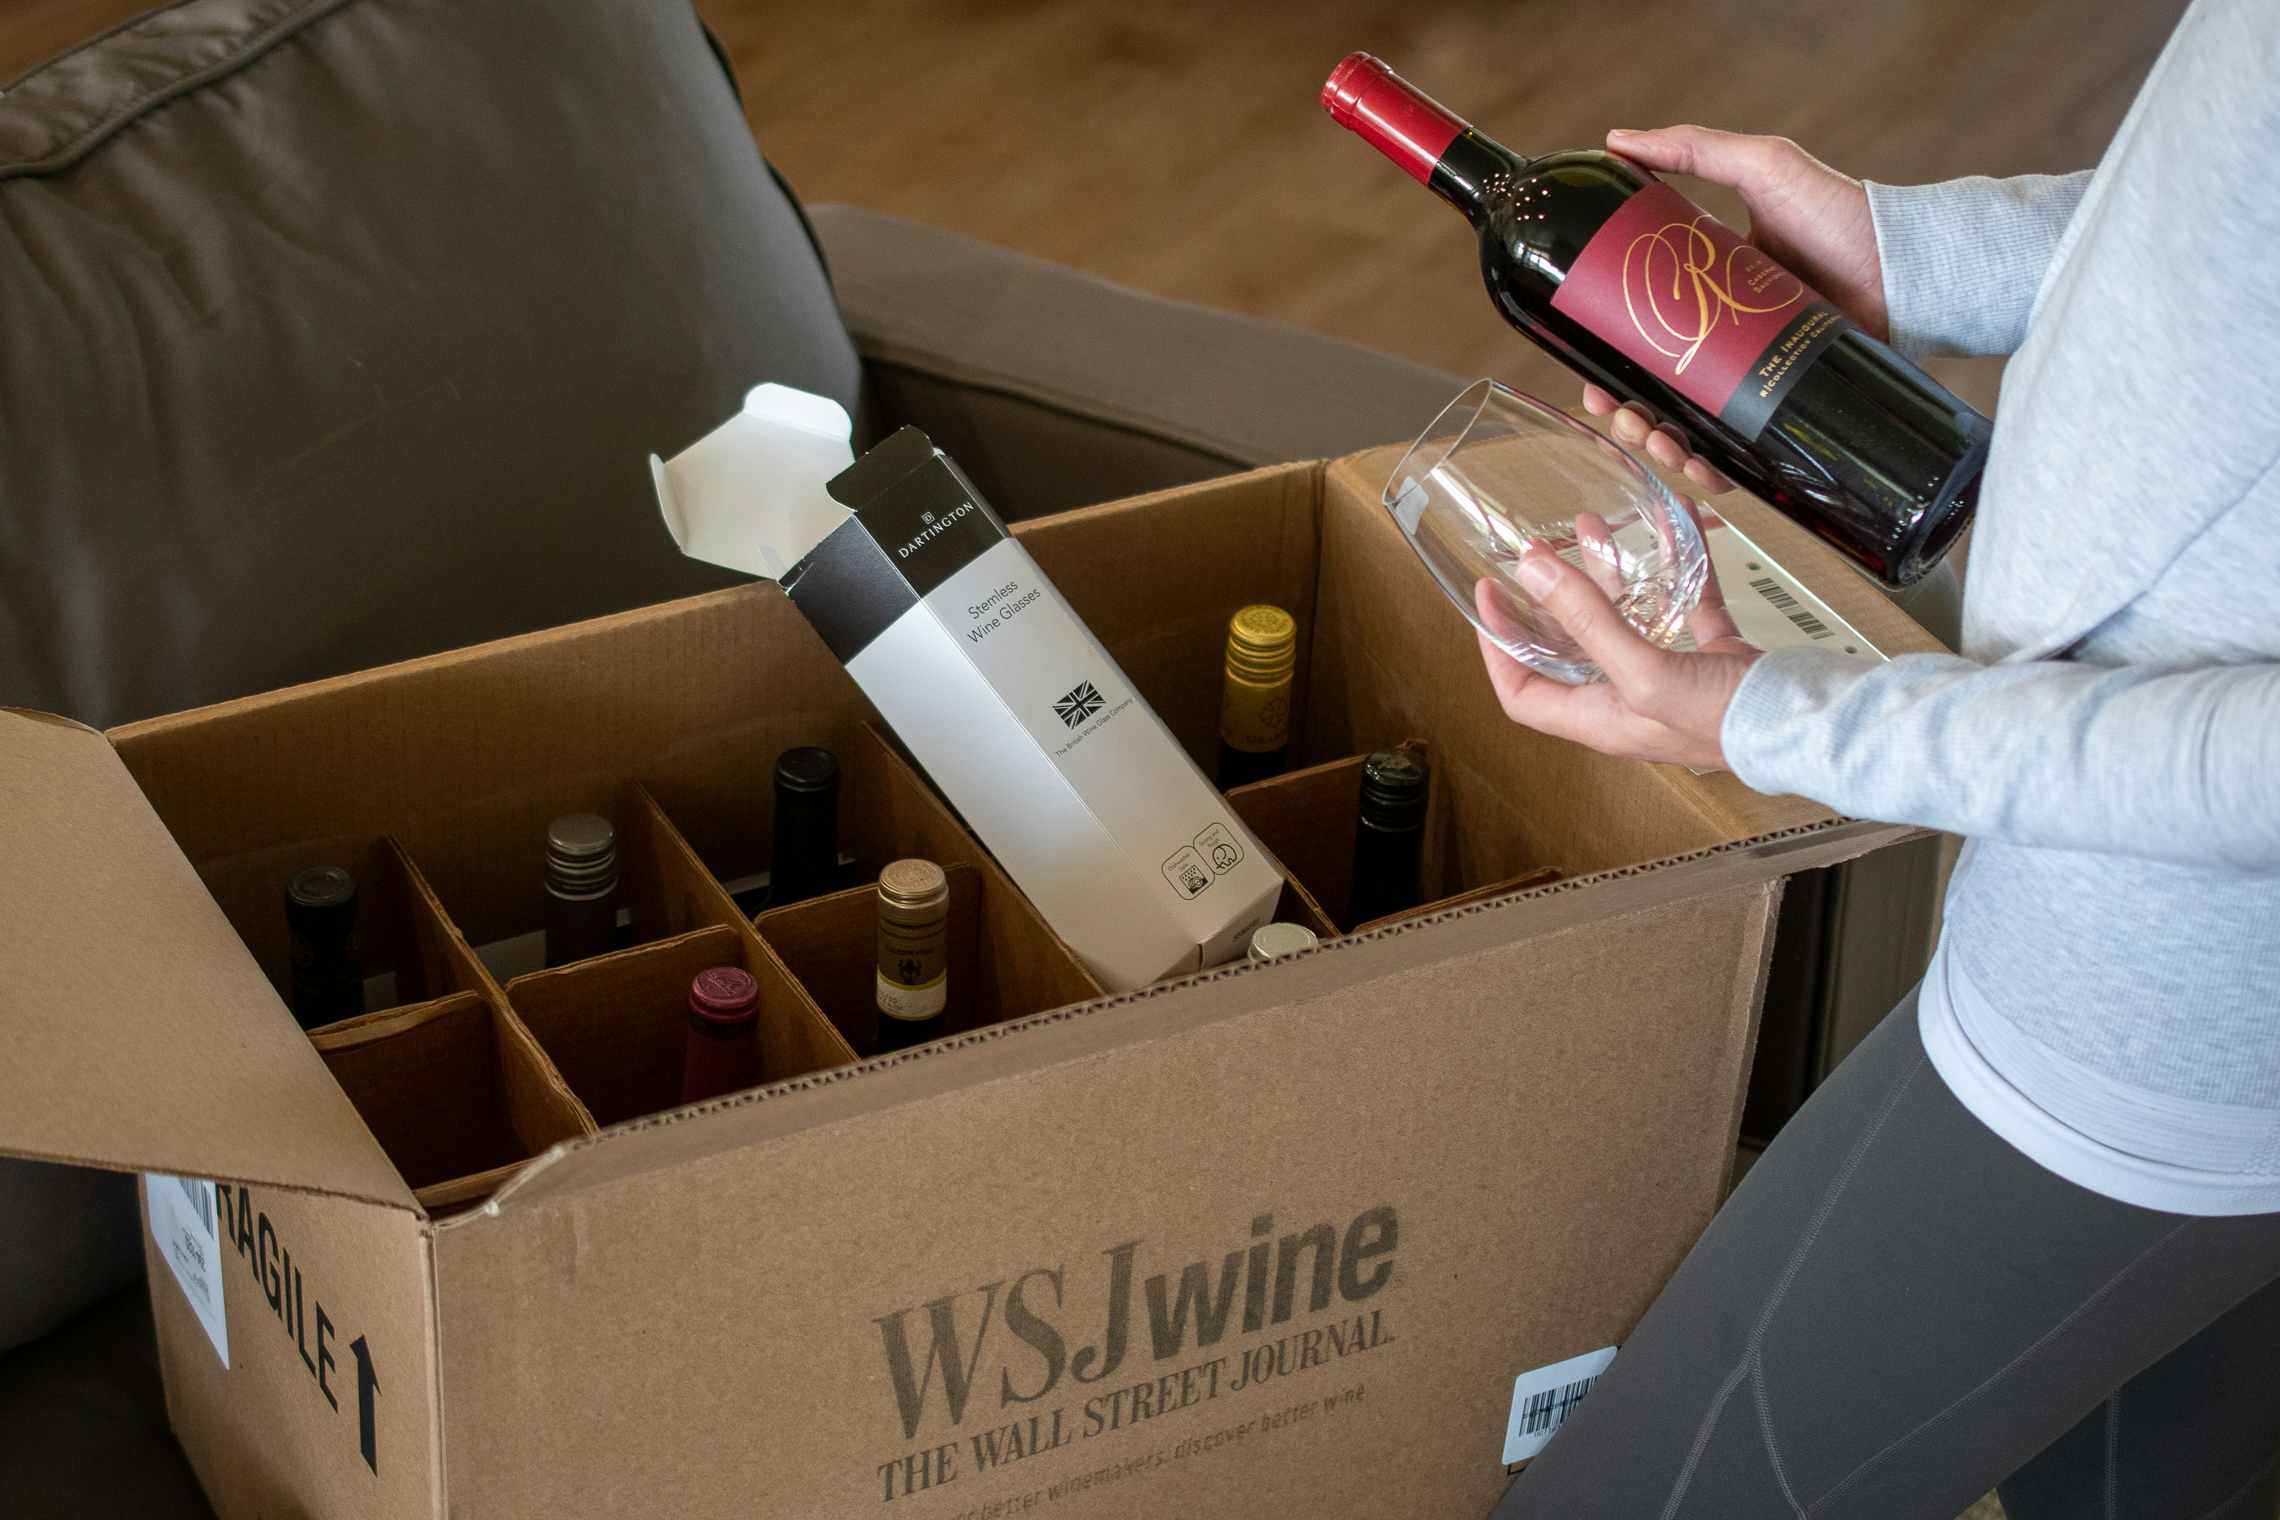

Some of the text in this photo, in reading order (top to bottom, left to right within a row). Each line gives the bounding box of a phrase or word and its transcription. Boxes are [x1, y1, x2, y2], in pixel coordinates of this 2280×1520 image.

[1758, 354, 1783, 377] THE
[898, 501, 975, 559] DARTINGTON
[966, 587, 1042, 643] Wine Glasses
[967, 580, 1019, 620] Stemless
[1081, 724, 1098, 737] Wine
[871, 1206, 1399, 1440] WSJwine
[877, 1441, 958, 1503] THE
[970, 1408, 1073, 1473] WALL
[1082, 1356, 1227, 1440] STREET
[1173, 1420, 1257, 1460] discover
[1260, 1401, 1318, 1434] better
[1322, 1384, 1366, 1411] wine
